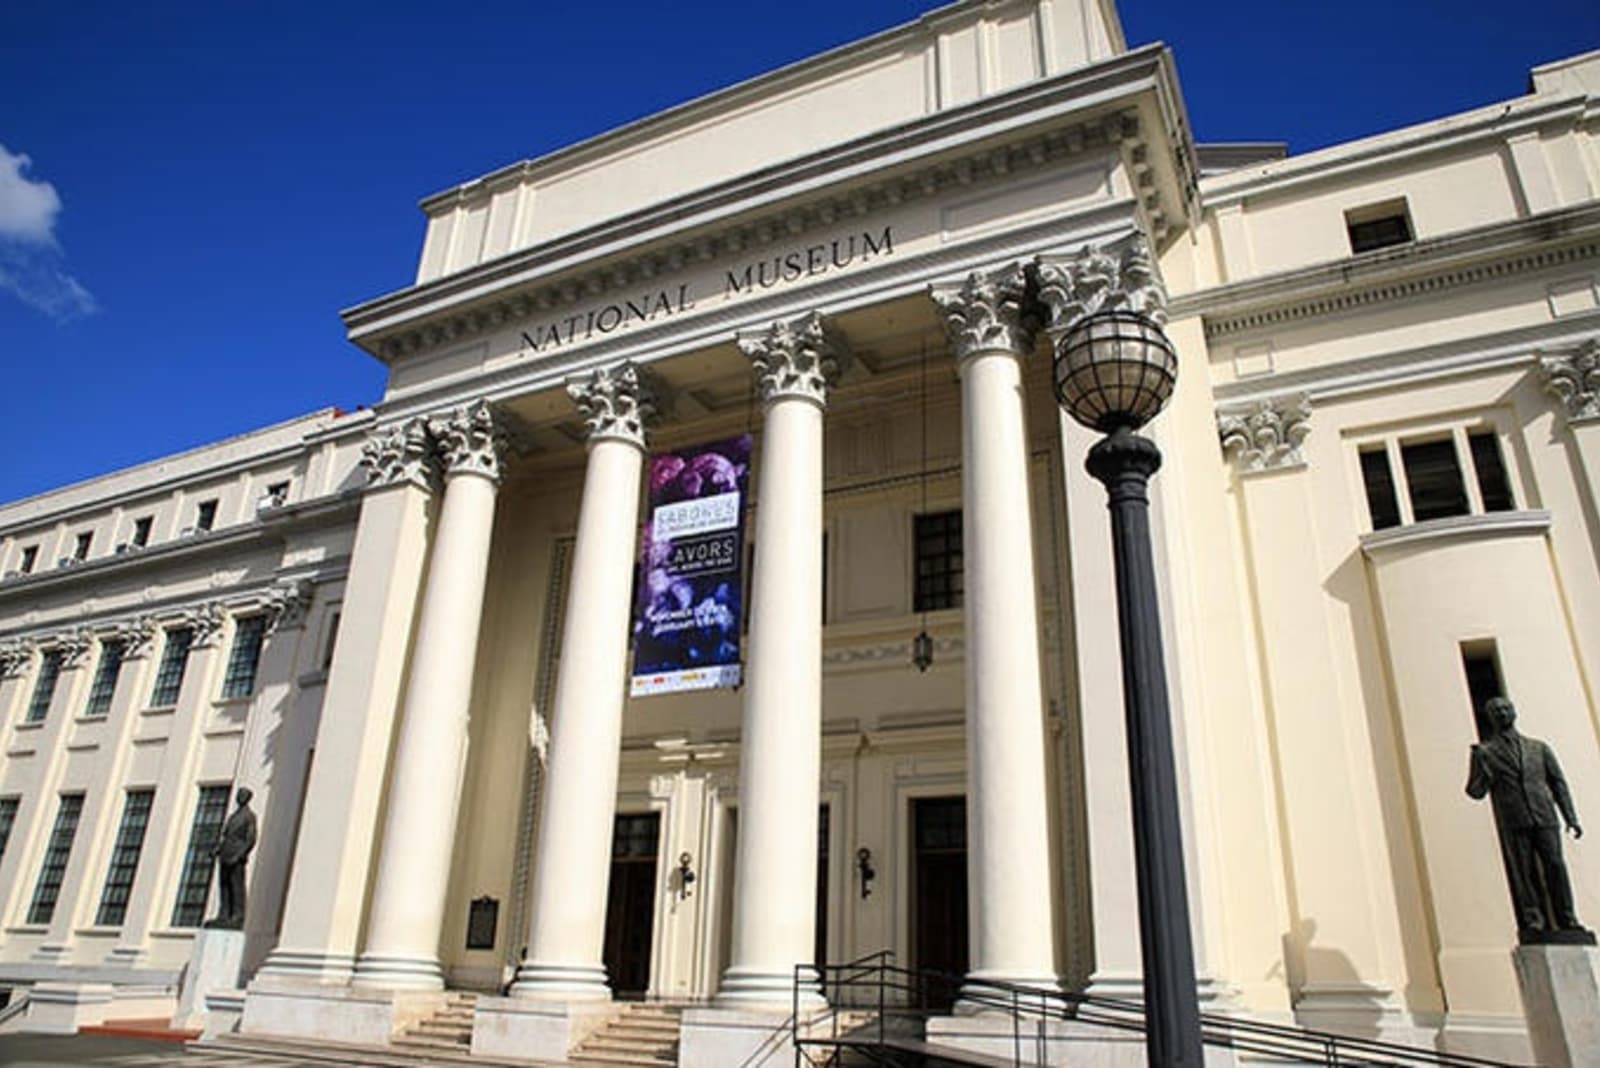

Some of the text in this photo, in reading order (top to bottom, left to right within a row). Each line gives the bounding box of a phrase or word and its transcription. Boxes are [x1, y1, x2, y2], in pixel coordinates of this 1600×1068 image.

[519, 226, 894, 357] NATIONAL MUSEUM
[660, 539, 733, 565] AVORS
